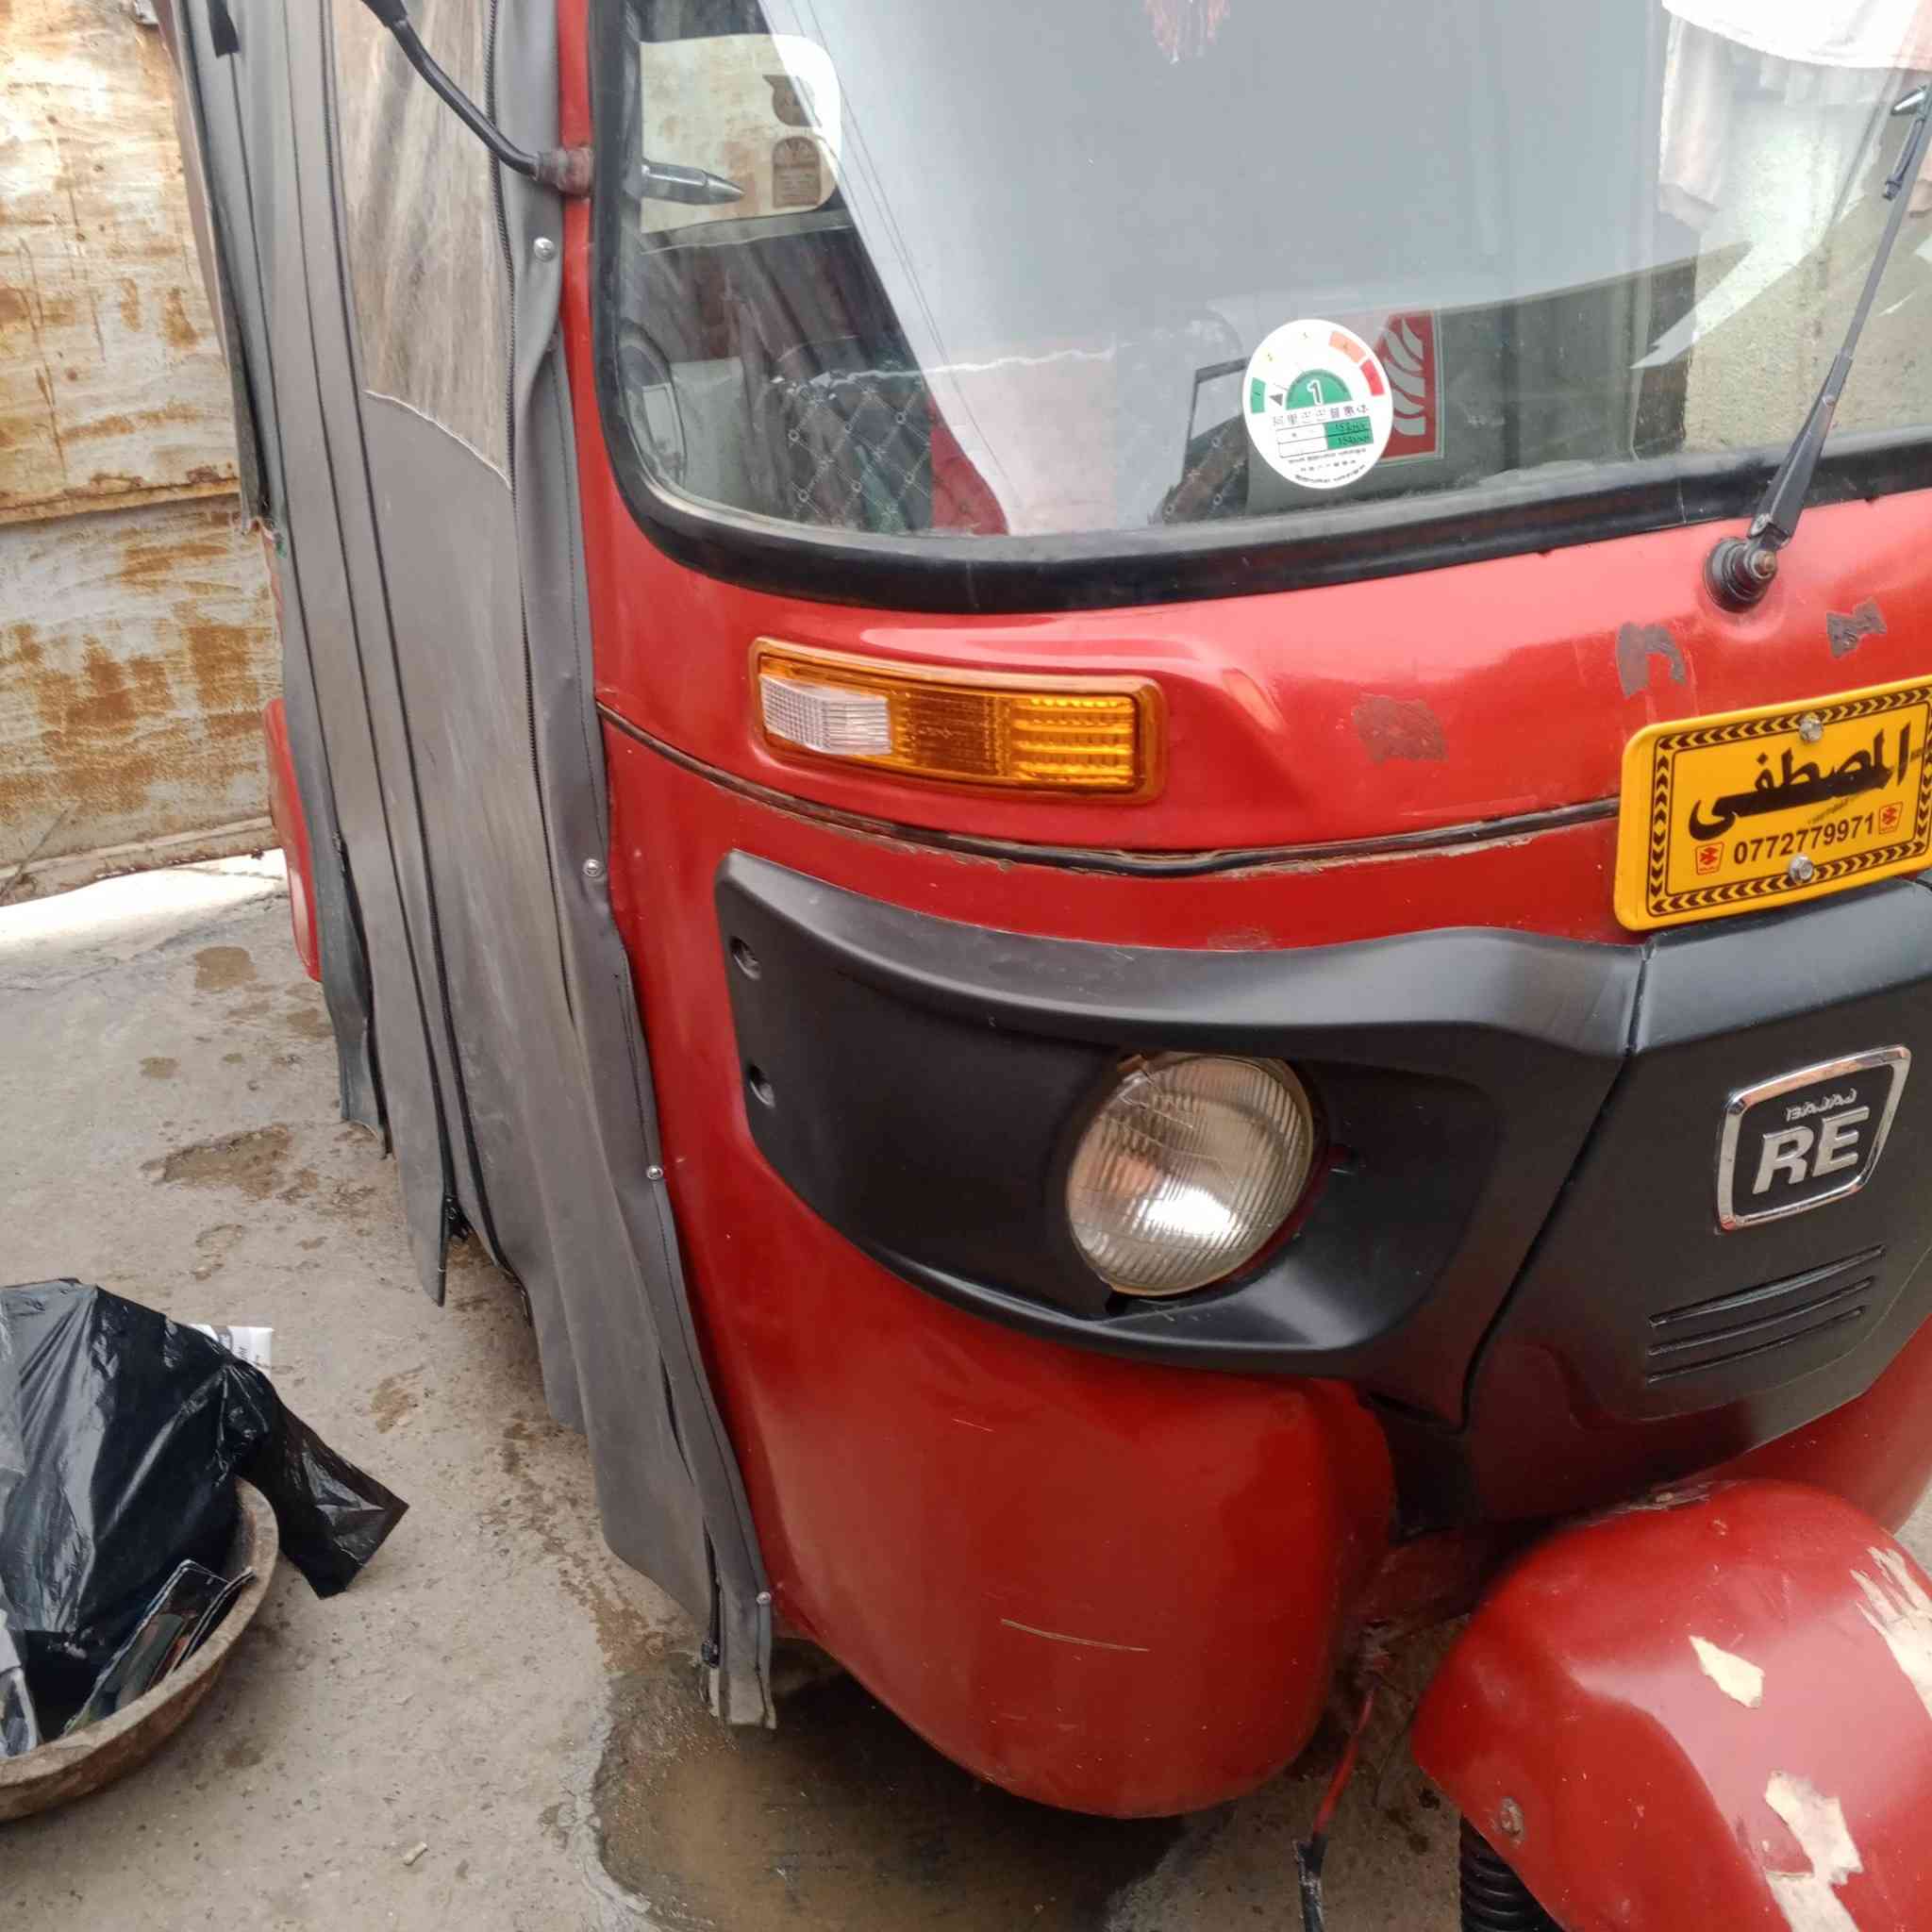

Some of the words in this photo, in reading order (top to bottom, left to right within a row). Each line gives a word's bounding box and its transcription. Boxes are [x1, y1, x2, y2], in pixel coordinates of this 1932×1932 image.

[1307, 378, 1324, 406] 1
[1733, 811, 1875, 865] 0772779971
[1786, 1088, 1858, 1123] BAJAJ
[1752, 1106, 1870, 1195] RE
